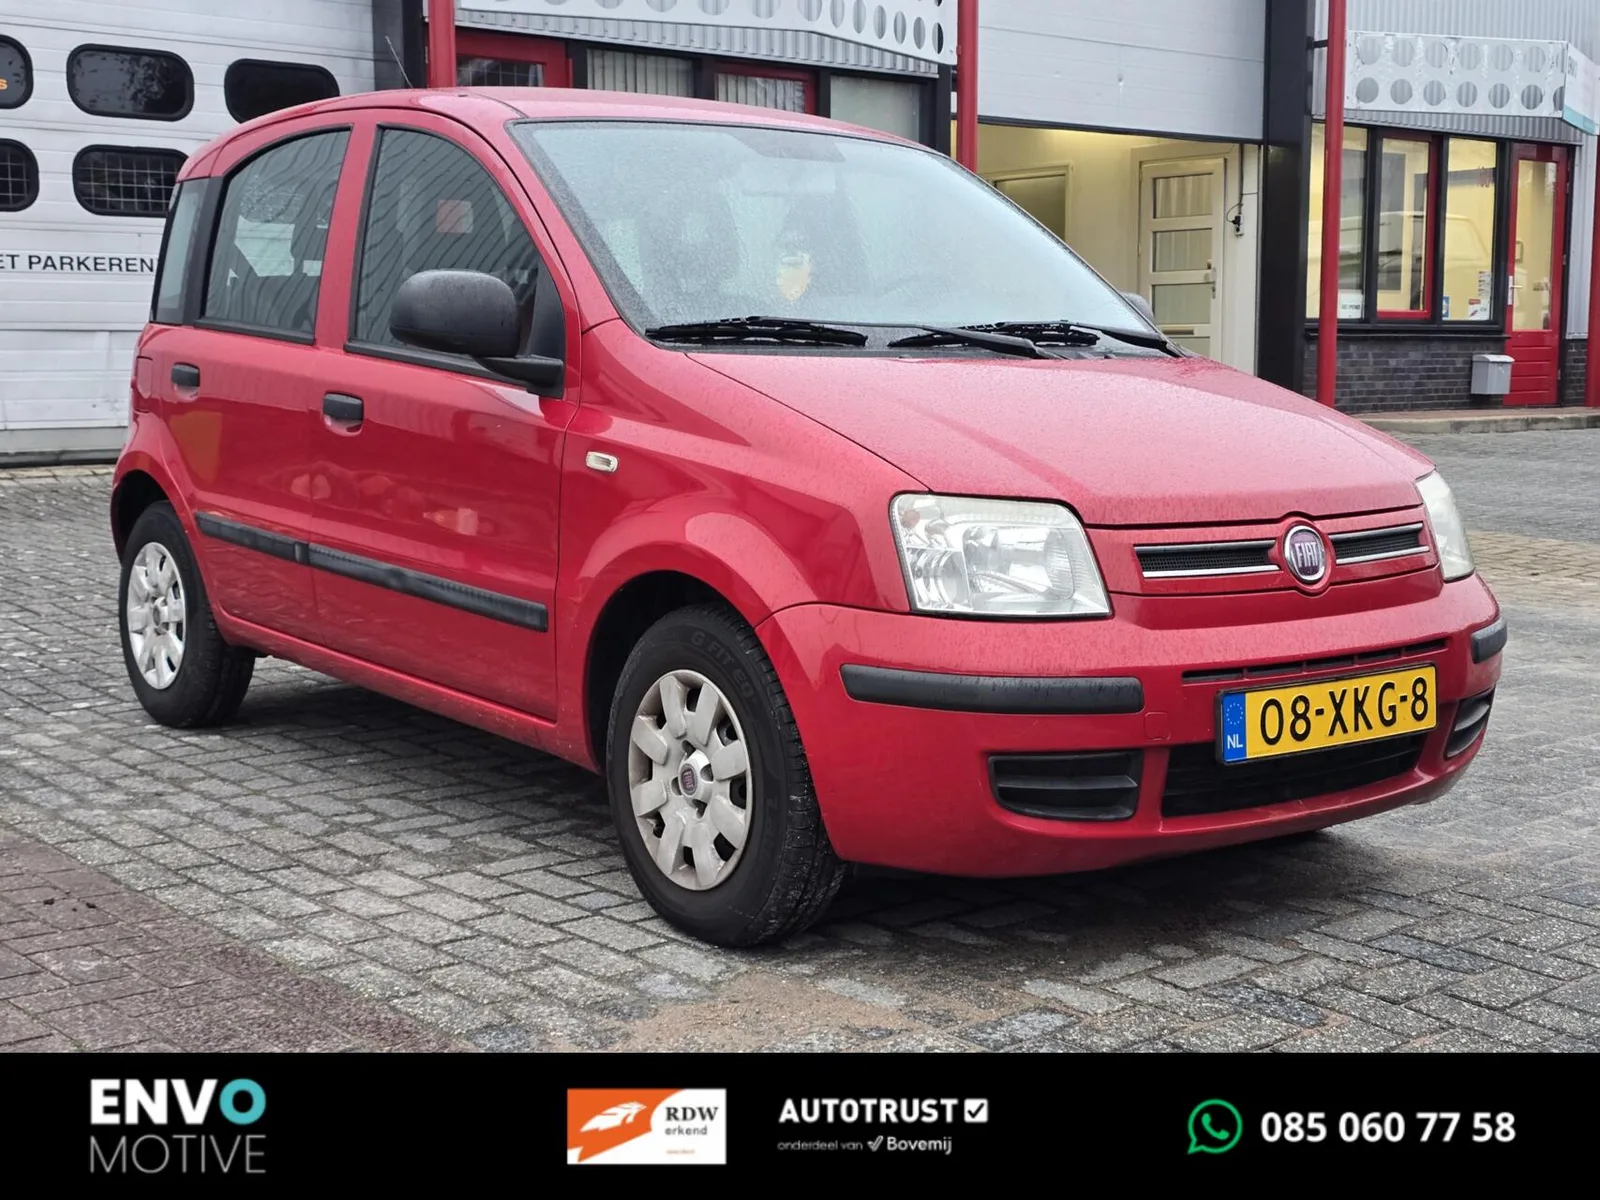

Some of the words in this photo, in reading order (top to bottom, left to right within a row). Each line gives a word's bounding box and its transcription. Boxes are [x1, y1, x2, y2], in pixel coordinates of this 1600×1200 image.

[28, 255, 154, 272] PARKEREN
[1294, 541, 1319, 568] FIAT
[1260, 677, 1429, 745] 08-XKG-8
[1227, 734, 1243, 749] NL
